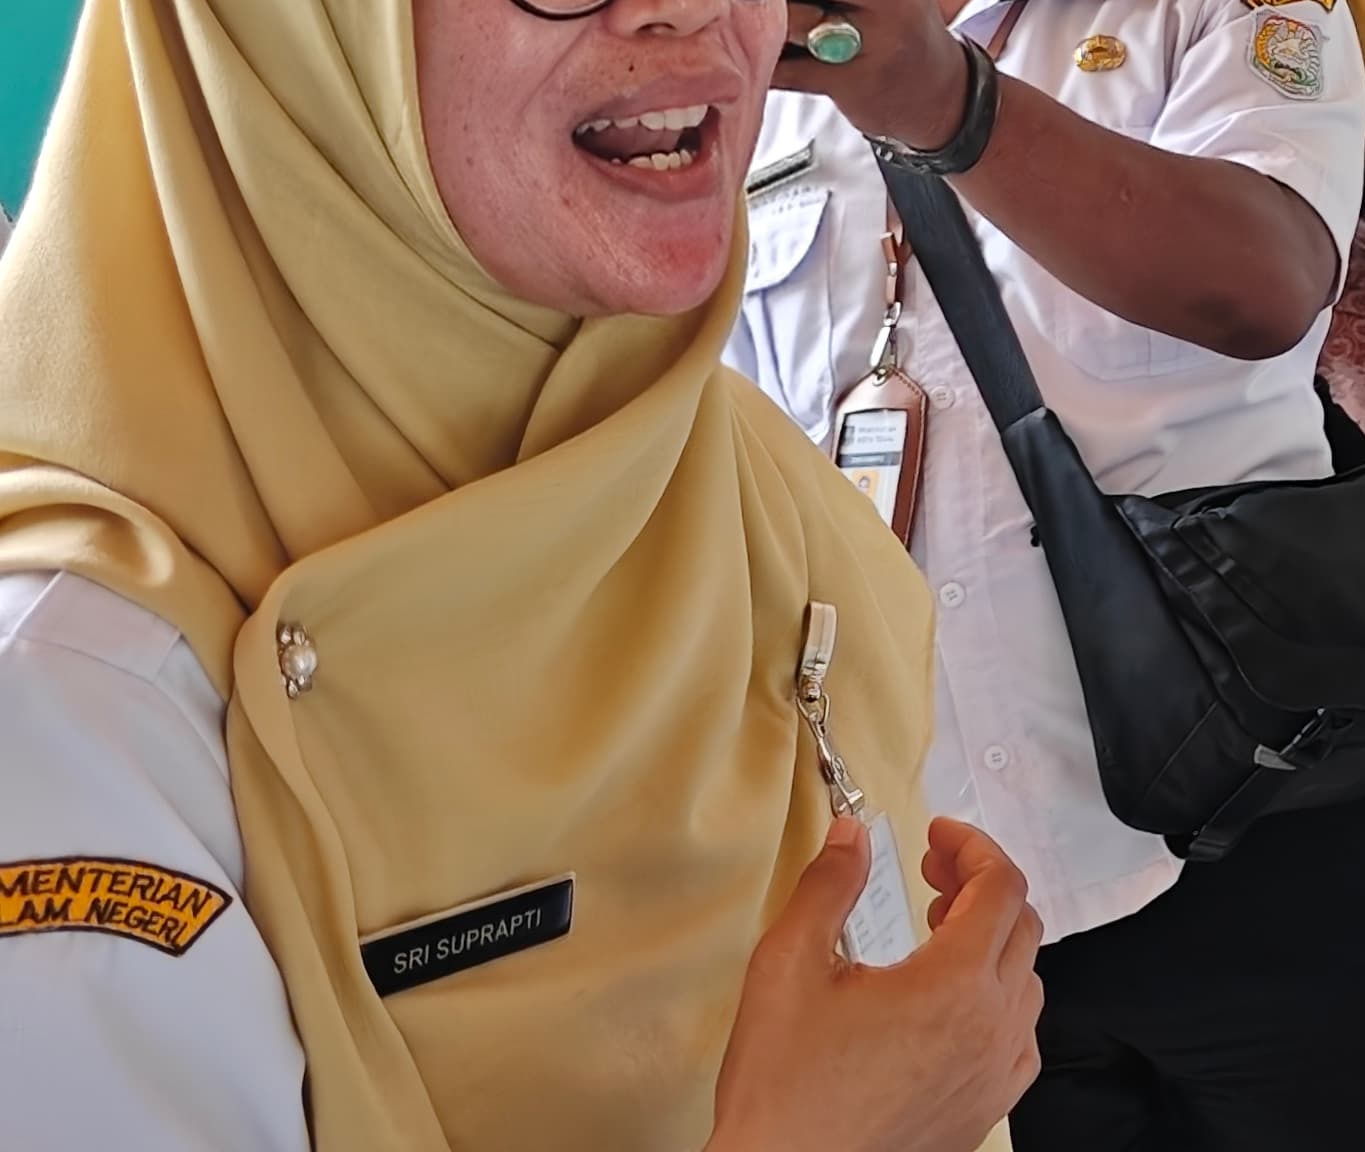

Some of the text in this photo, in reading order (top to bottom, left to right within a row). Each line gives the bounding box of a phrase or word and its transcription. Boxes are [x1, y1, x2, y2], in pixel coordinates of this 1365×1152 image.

[85, 898, 188, 946] NEGERI
[393, 908, 542, 974] SRI SUPRAPTI
